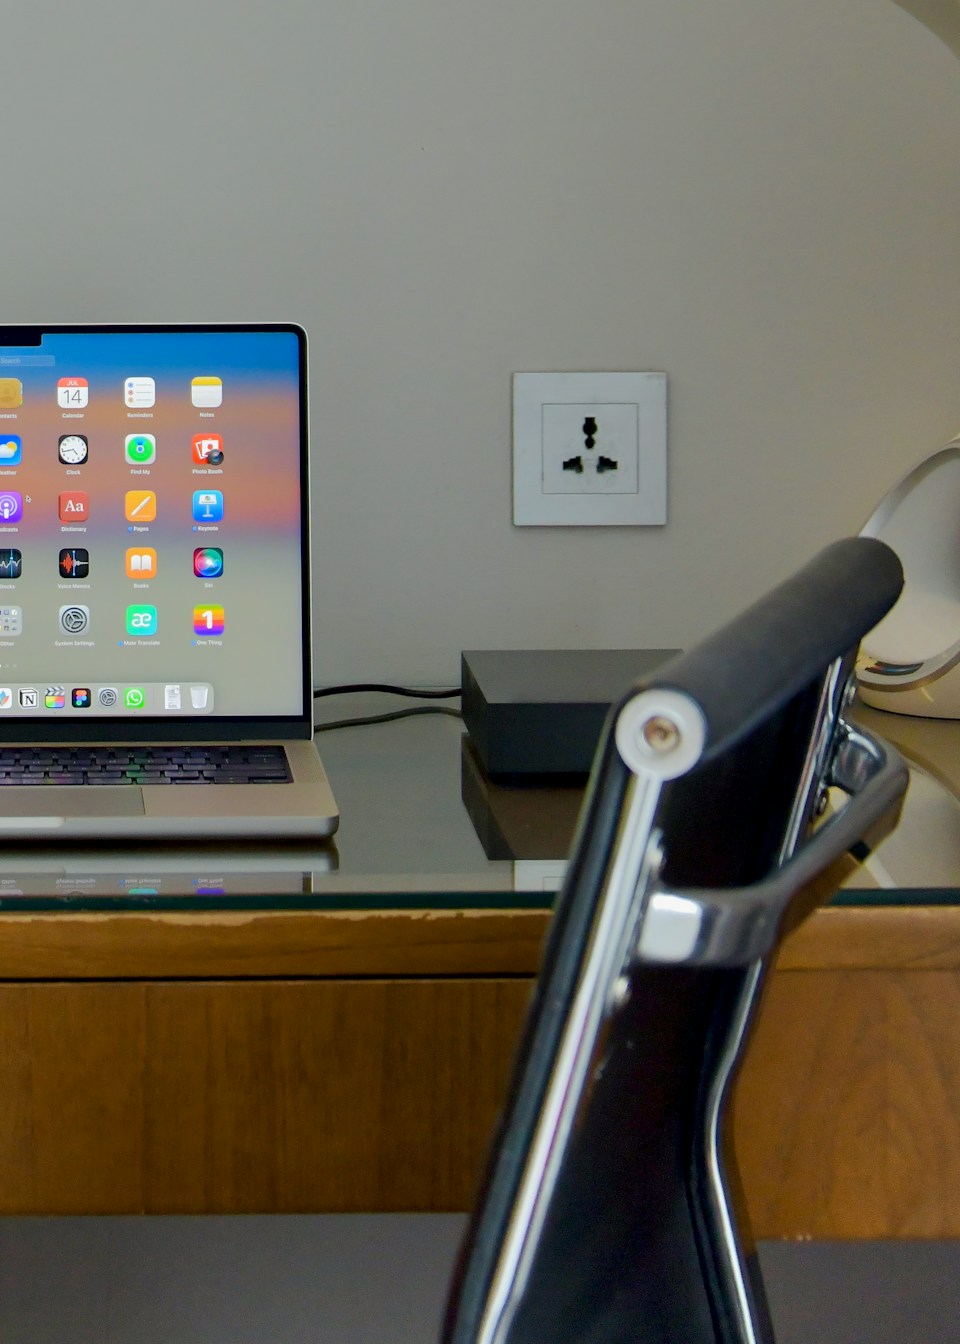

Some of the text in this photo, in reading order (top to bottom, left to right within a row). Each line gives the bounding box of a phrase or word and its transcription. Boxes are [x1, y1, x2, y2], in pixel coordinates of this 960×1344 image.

[66, 379, 79, 387] JUL
[63, 388, 83, 405] 14
[64, 498, 85, 513] Aa
[60, 526, 87, 534] Dictionary
[201, 609, 214, 630] 1
[54, 640, 95, 648] System Settings
[24, 694, 36, 706] N
